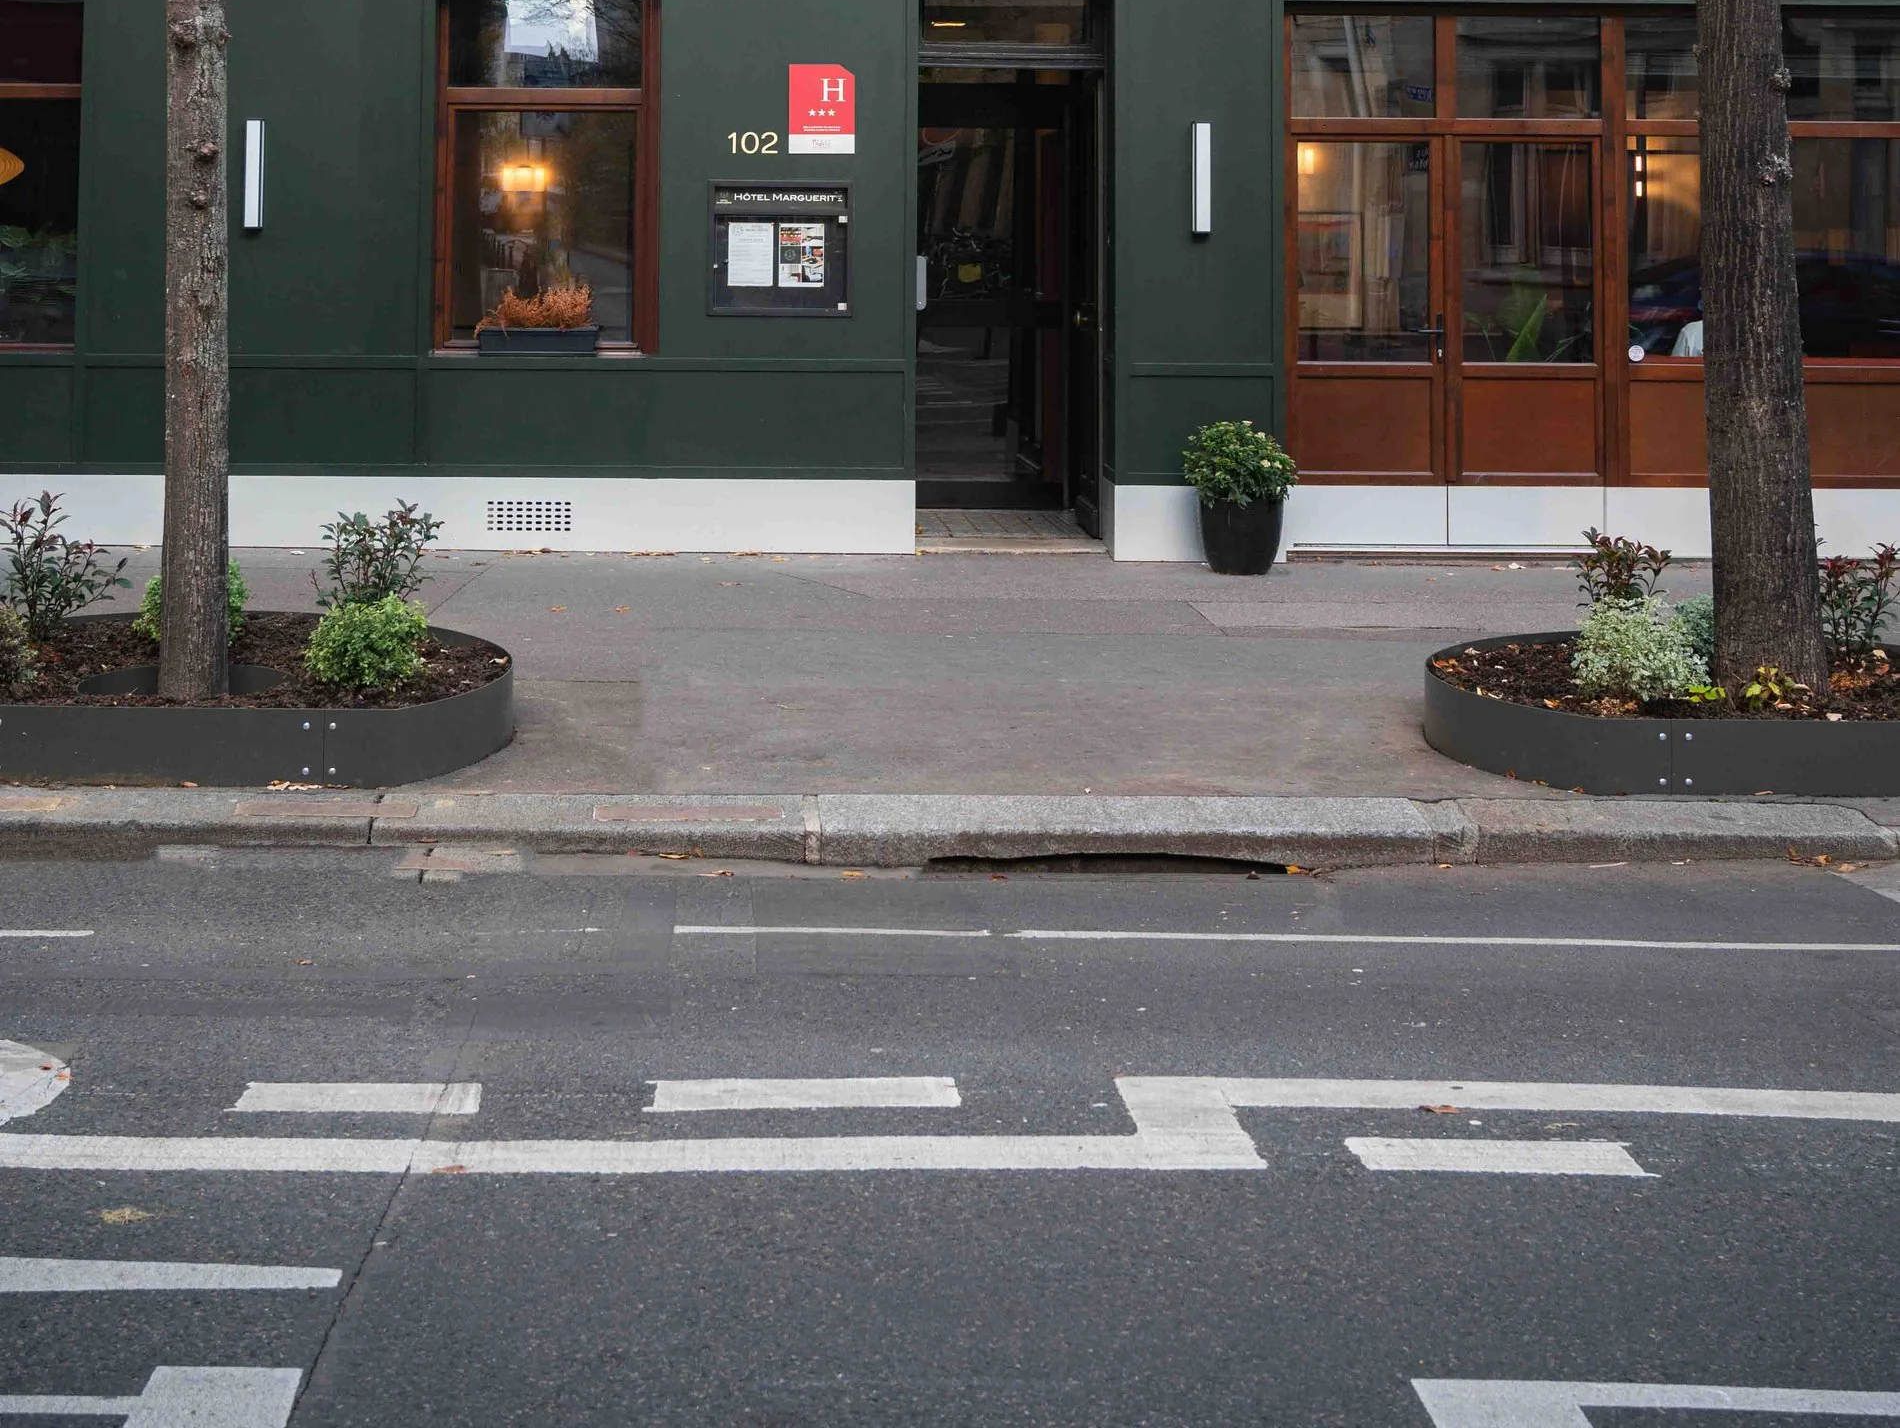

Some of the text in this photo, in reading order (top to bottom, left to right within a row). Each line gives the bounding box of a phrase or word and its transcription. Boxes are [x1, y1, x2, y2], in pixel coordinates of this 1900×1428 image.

[820, 78, 846, 102] H
[727, 131, 779, 154] 102
[733, 192, 771, 202] HÔTEL
[772, 193, 843, 203] MARGUERITE
